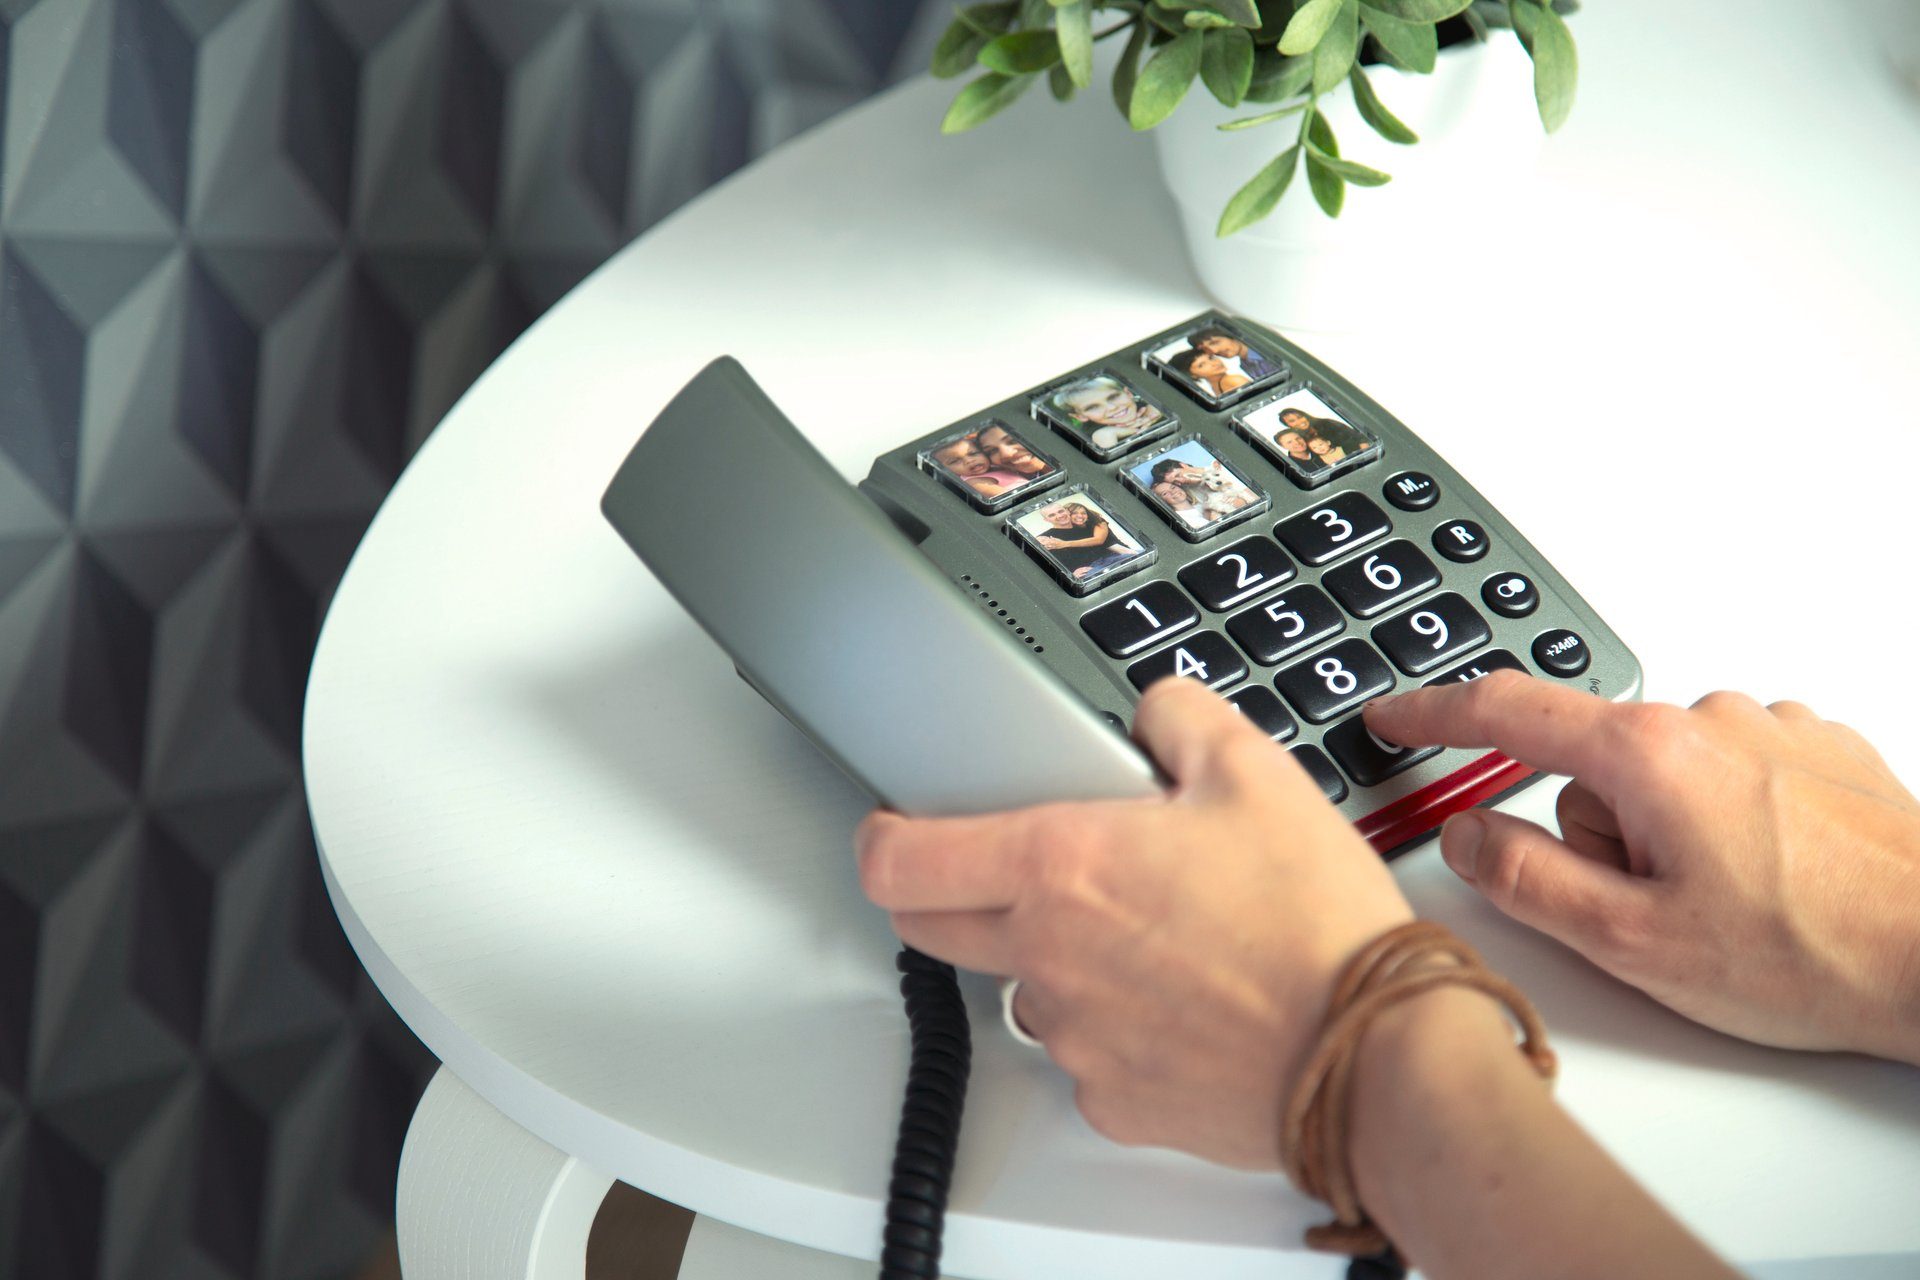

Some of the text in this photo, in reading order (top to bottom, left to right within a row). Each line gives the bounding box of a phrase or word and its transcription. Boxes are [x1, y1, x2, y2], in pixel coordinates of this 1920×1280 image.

[1311, 508, 1353, 542] 3
[1449, 525, 1475, 545] R
[1216, 553, 1263, 589] 2
[1363, 555, 1402, 590] 6
[1125, 598, 1161, 628] 1
[1264, 599, 1305, 638] 5
[1410, 611, 1449, 650] 9
[1546, 635, 1579, 657] +24dB
[1175, 647, 1209, 680] 4
[1314, 657, 1357, 695] 8
